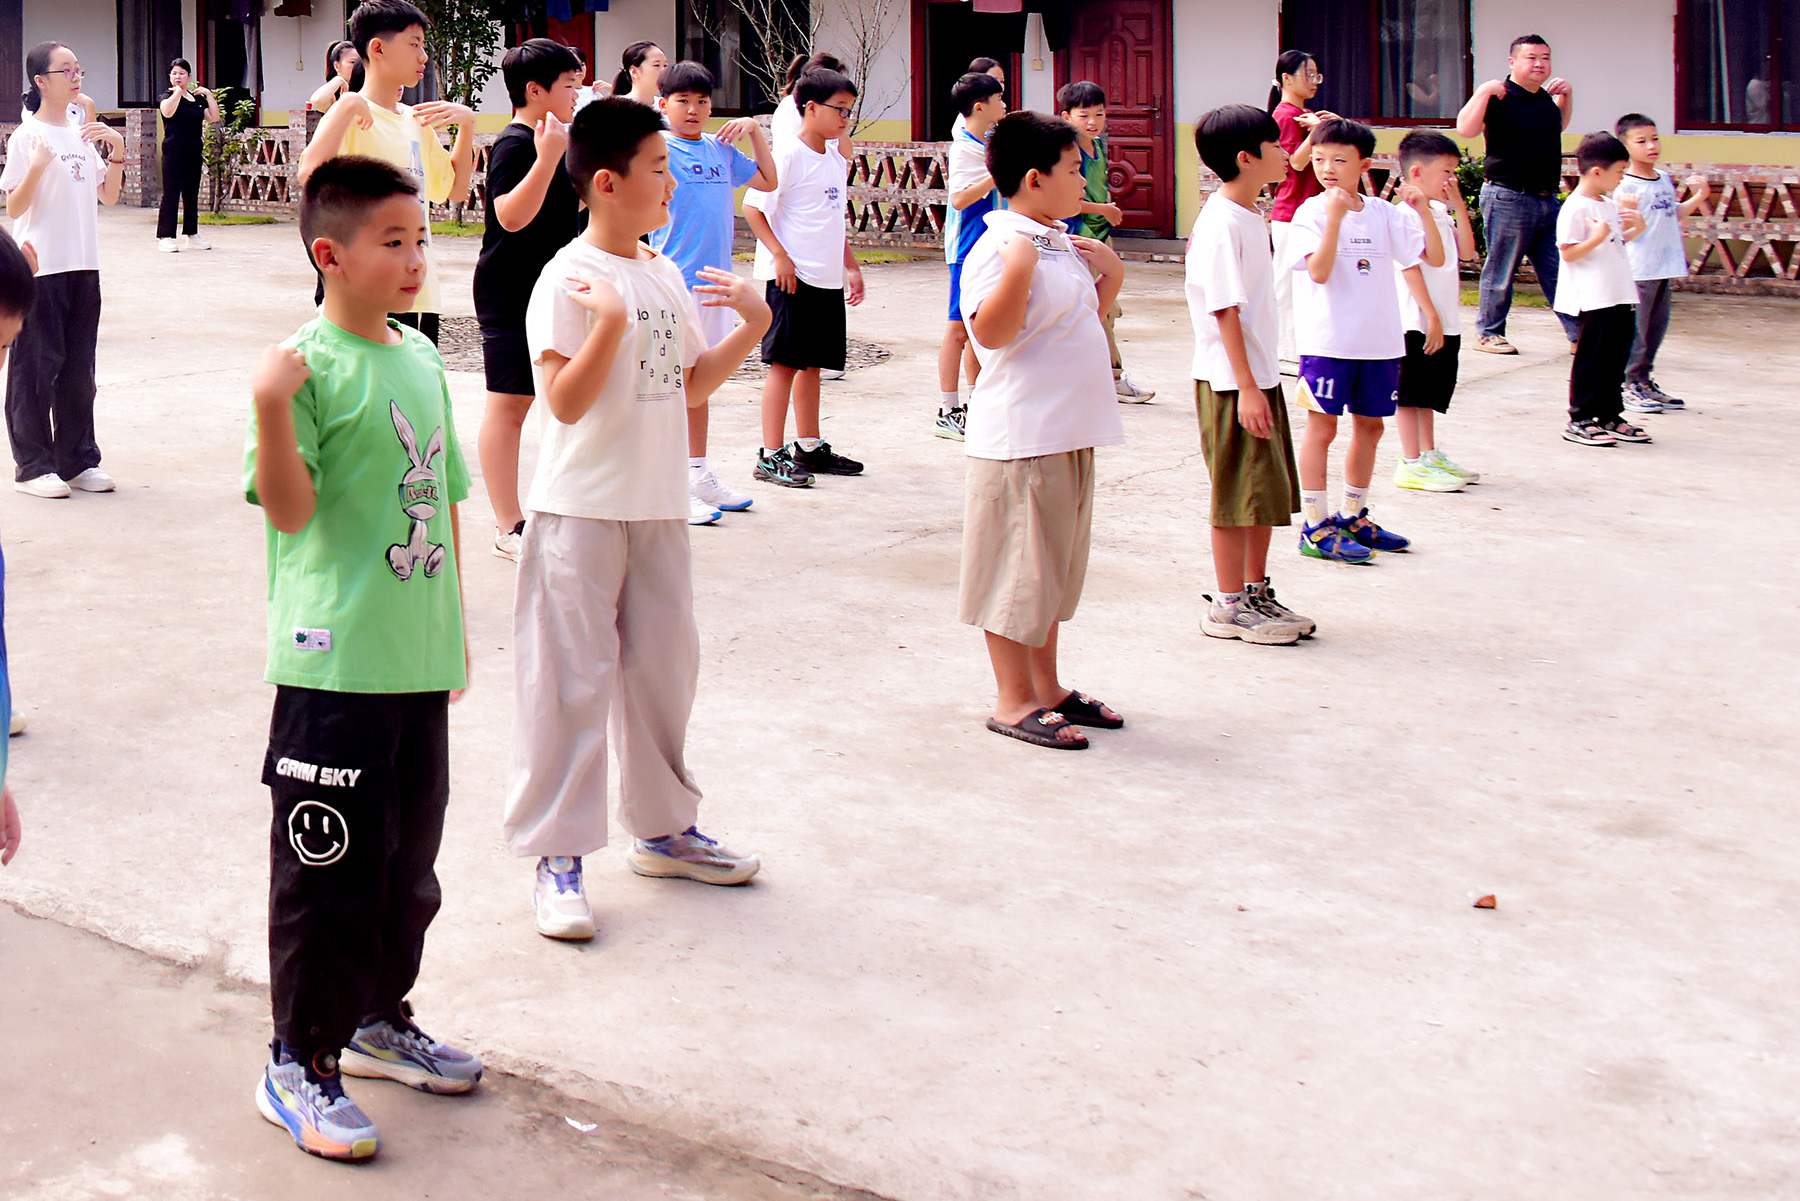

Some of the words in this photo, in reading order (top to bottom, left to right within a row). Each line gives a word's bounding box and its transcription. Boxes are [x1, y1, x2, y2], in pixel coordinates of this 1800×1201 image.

[1314, 376, 1335, 400] 11
[275, 757, 318, 783] GRIM
[319, 767, 361, 787] SKY
